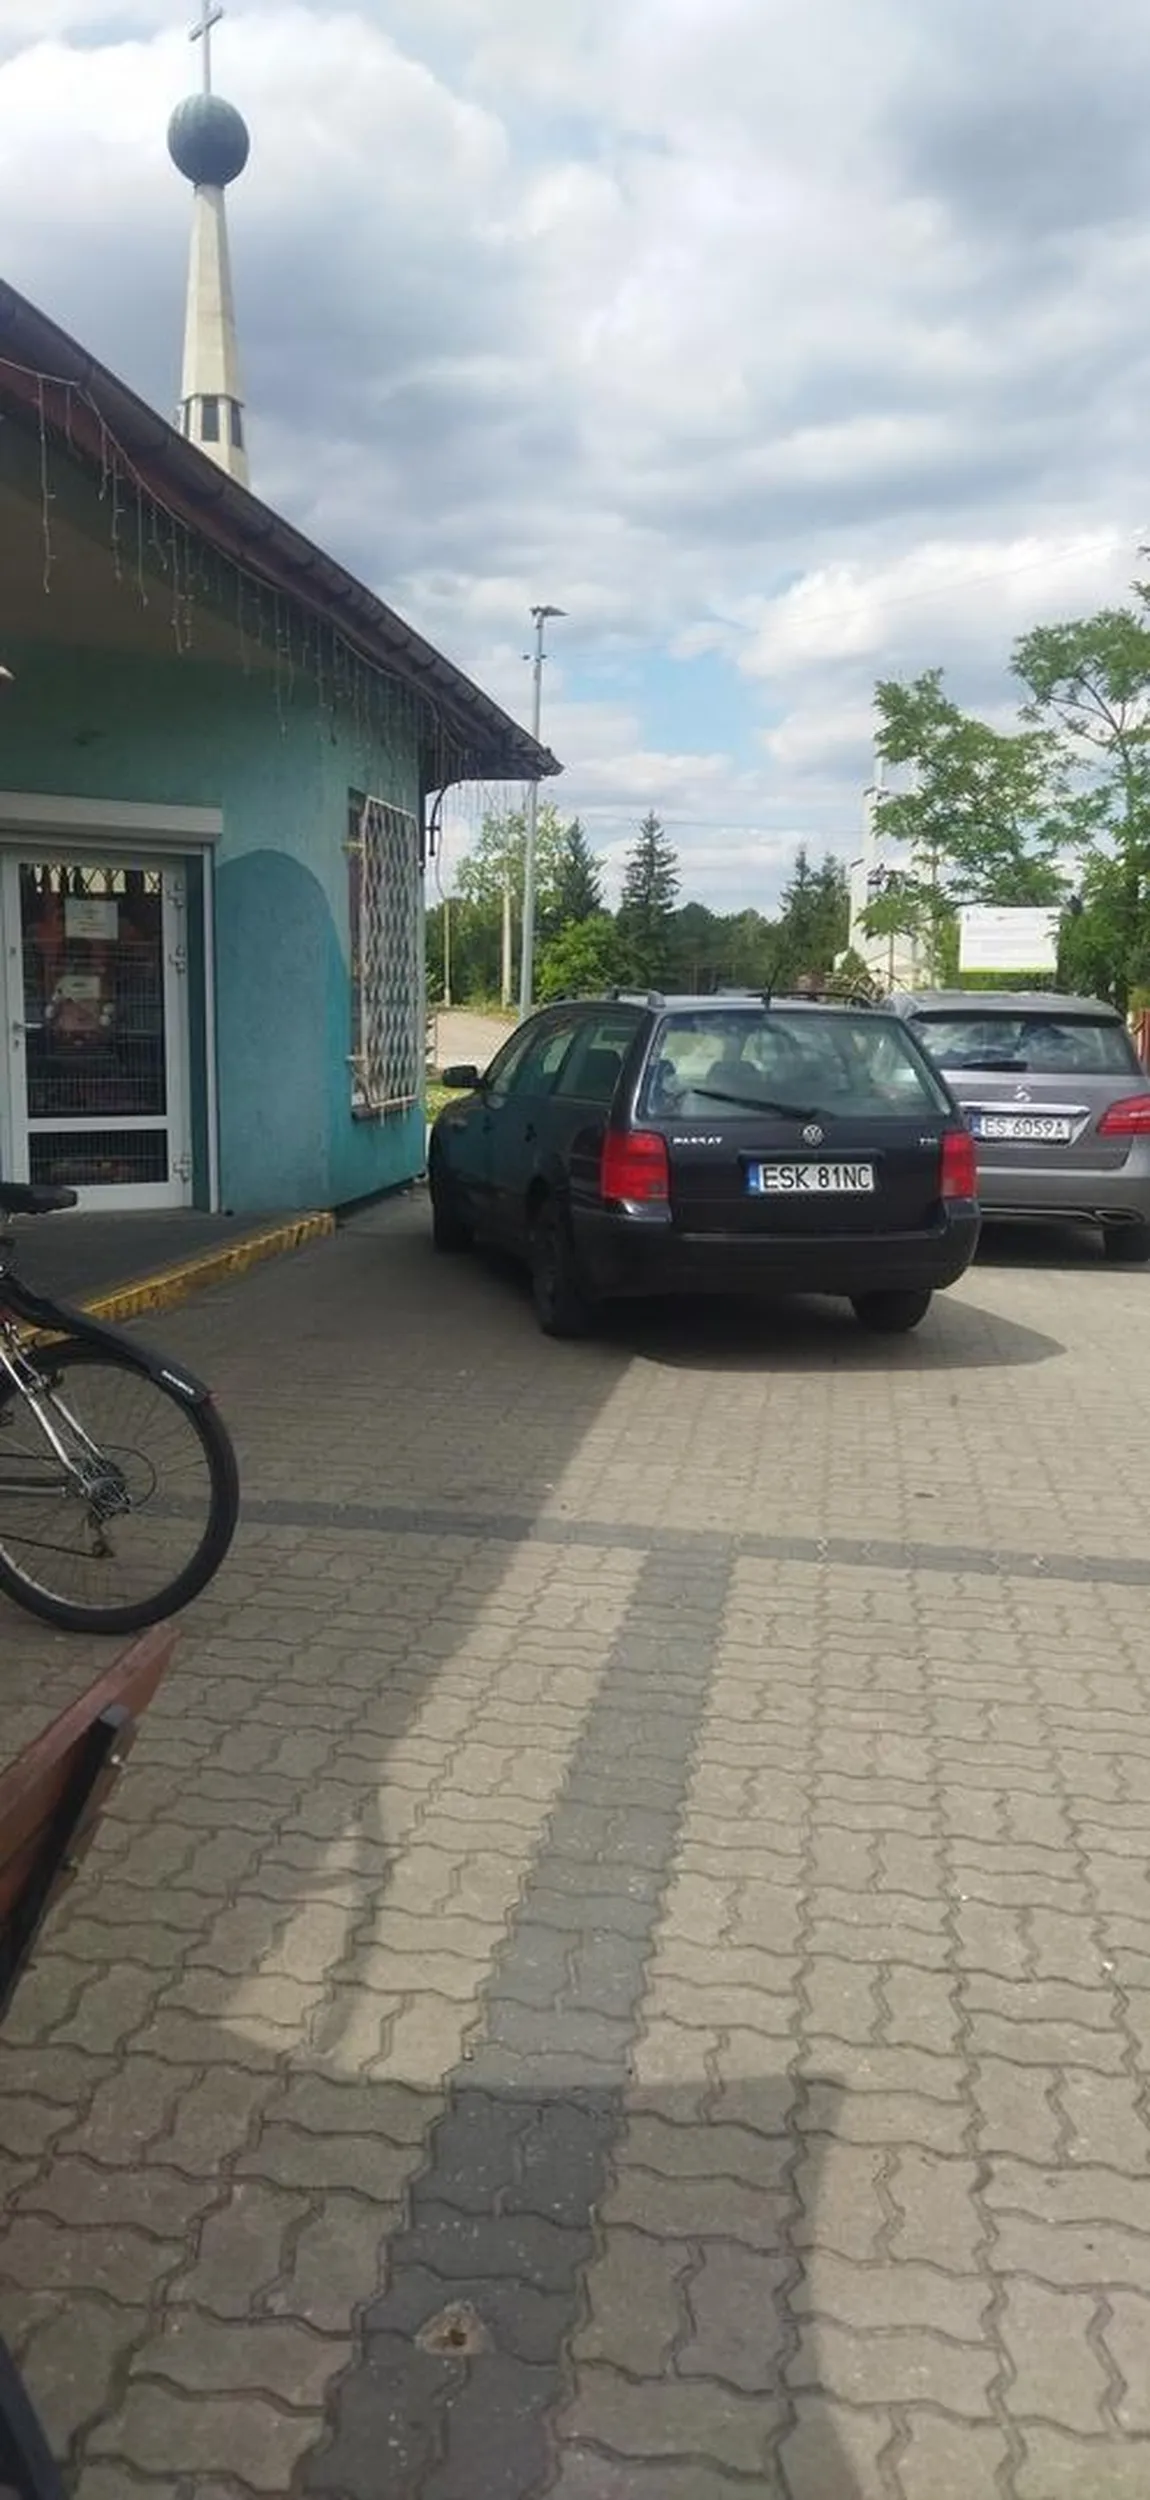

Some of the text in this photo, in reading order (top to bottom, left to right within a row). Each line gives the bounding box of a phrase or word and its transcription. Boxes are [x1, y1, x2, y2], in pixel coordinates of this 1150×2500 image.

[985, 1118, 1006, 1135] ES
[763, 1166, 870, 1189] ESK 81NC
